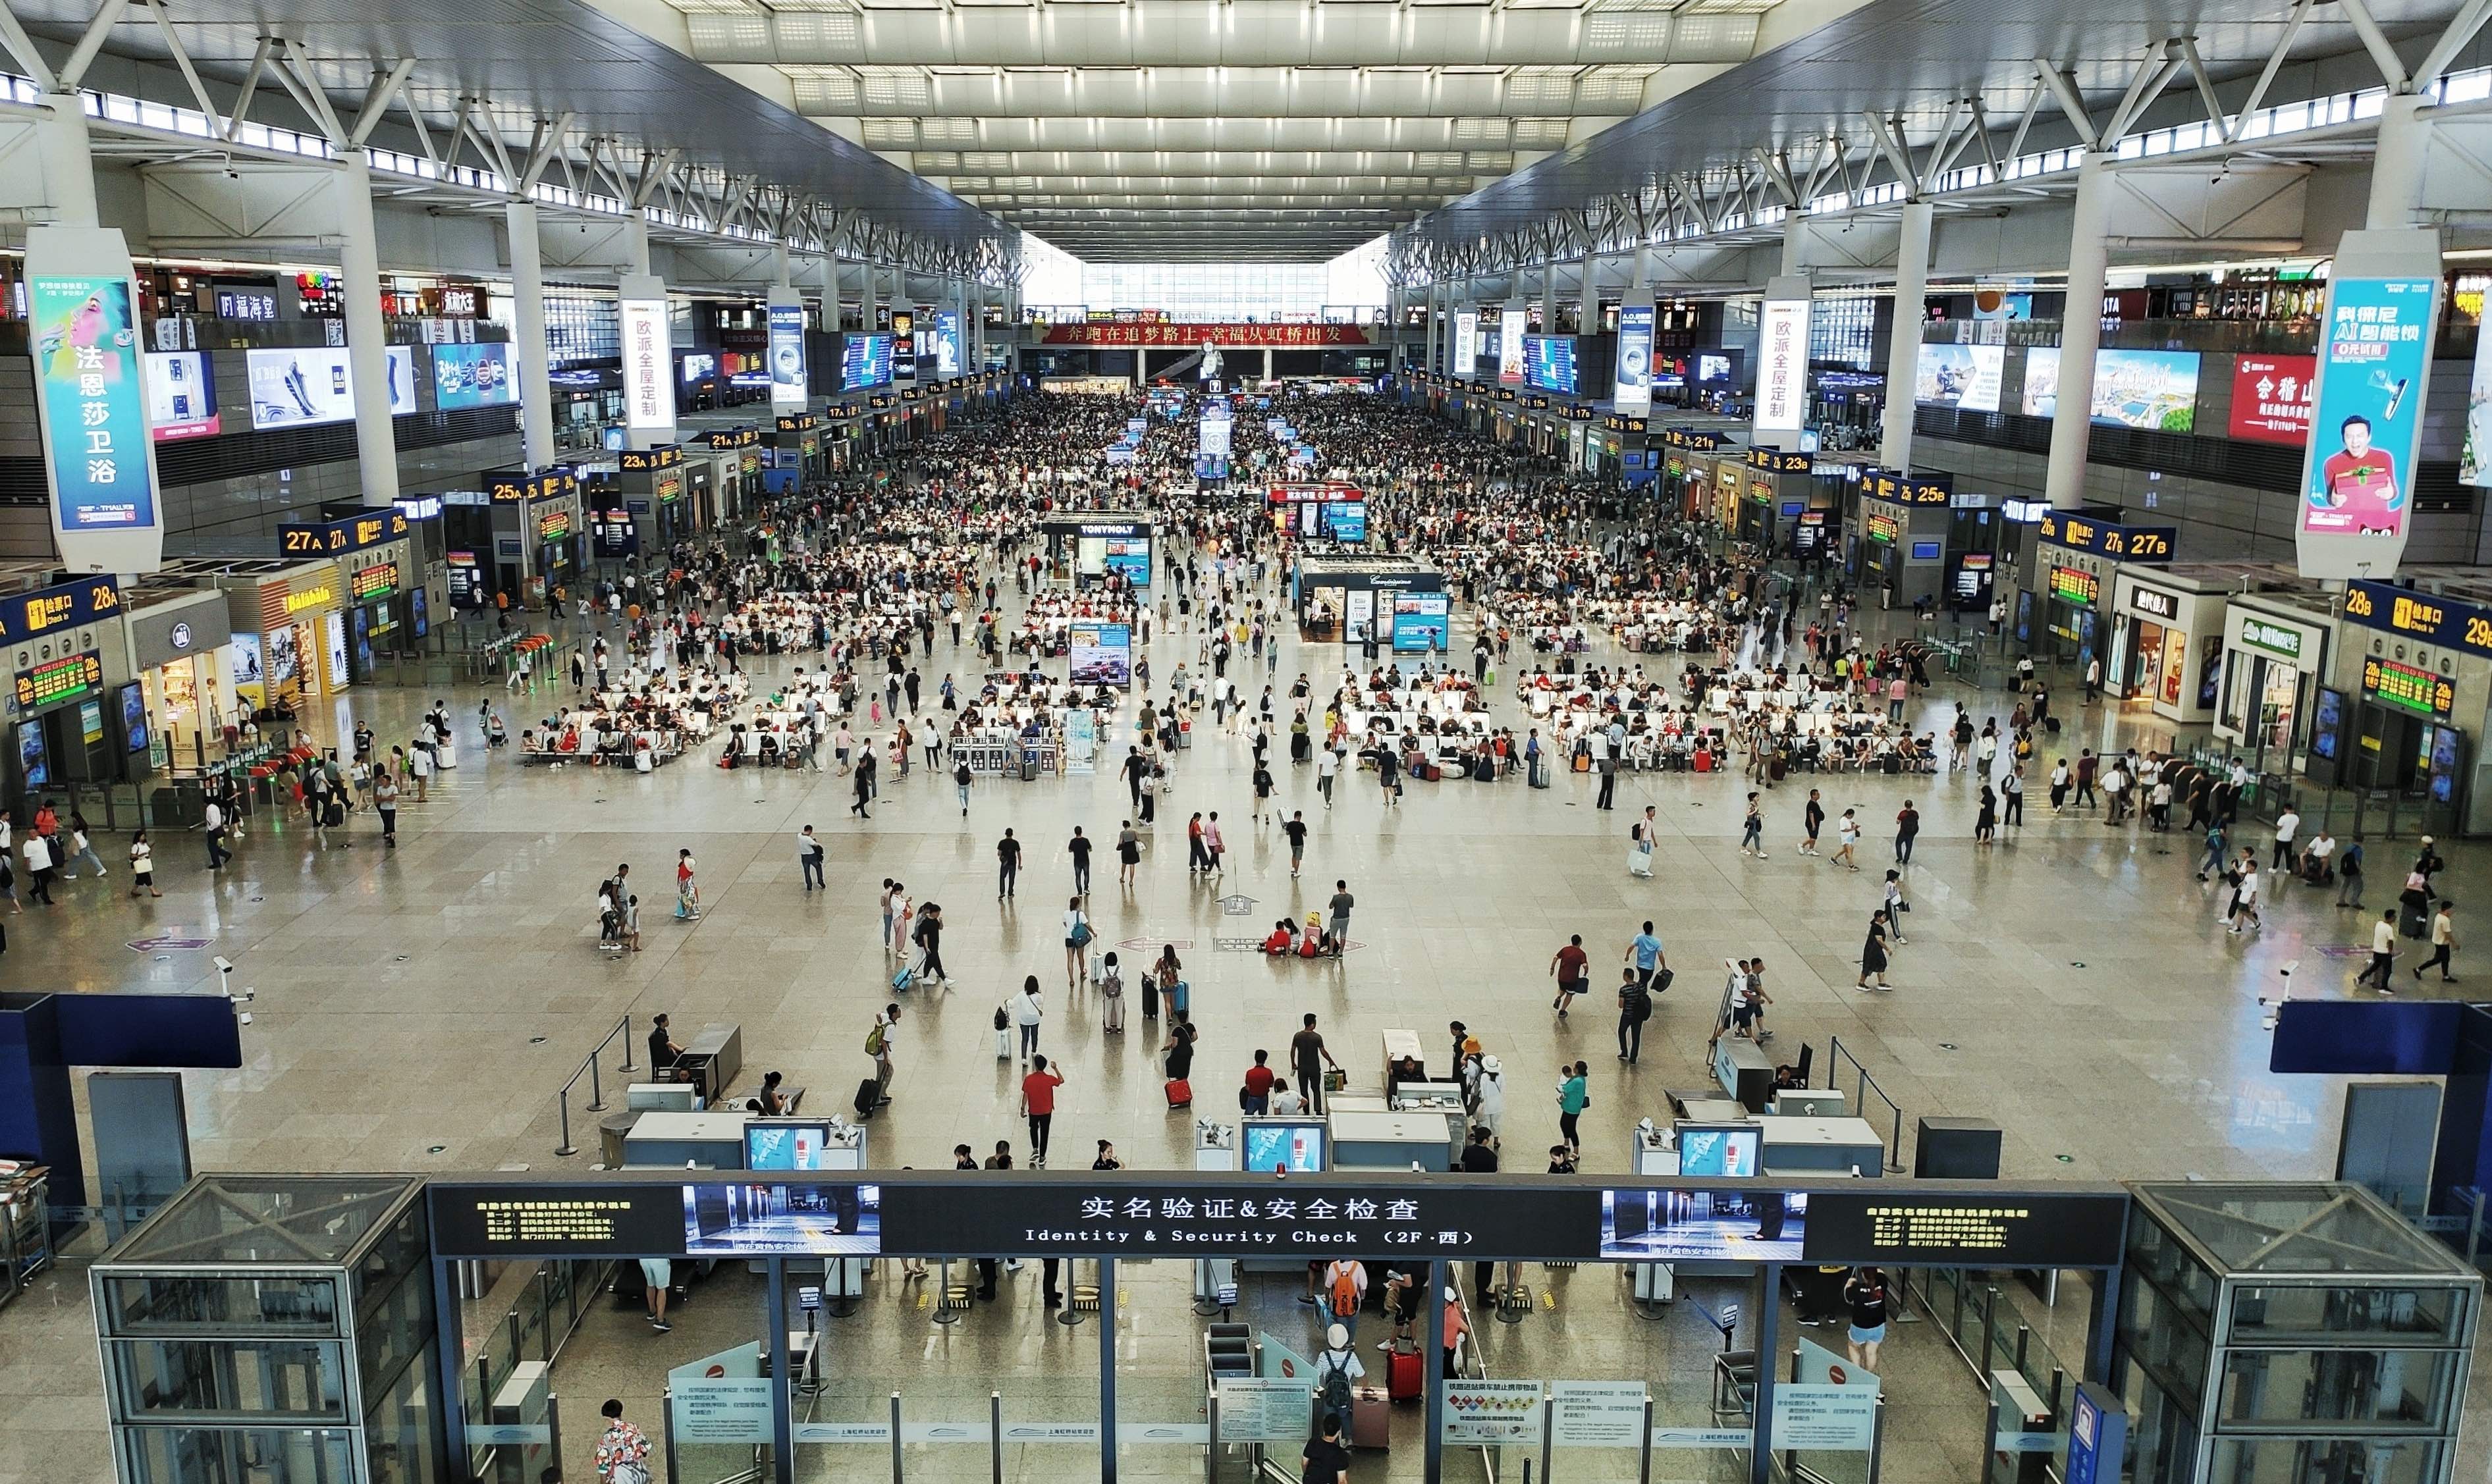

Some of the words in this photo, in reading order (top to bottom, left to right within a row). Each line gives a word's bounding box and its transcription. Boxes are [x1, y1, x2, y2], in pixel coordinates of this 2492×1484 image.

[236, 294, 275, 321] 福海堂
[445, 290, 475, 311] 永和大王
[2103, 297, 2119, 315] STA
[2173, 302, 2191, 311] LVERS
[1067, 326, 1198, 342] 奔跑在追梦路上
[1210, 326, 1341, 342] 幸福从虹桥出发
[2334, 322, 2420, 341] AI智能锁
[2339, 344, 2382, 356] 0元试用
[637, 320, 657, 417] 欧派全屋定制
[1770, 321, 1791, 417] 欧派全屋定制
[2256, 375, 2314, 402] 会稽山
[74, 344, 117, 485] 法恩莎卫浴
[829, 408, 844, 417] 17A
[1577, 410, 1590, 418] 17B
[779, 420, 796, 429] 19A
[1628, 421, 1643, 430] 19B
[713, 435, 732, 446] 21A
[1694, 437, 1714, 448] 21B
[624, 456, 646, 467] 23A
[1785, 457, 1808, 469] 23B
[495, 484, 522, 499] 25A
[1917, 487, 1945, 502] 25B
[393, 516, 407, 533] 26A
[1081, 525, 1133, 534] TONYMOLY
[2041, 517, 2055, 536] 26B
[286, 531, 323, 550] 27A
[330, 529, 347, 549] 27A
[2105, 531, 2123, 553] 27B
[2131, 534, 2167, 554] 27B
[45, 595, 72, 614] 检票口
[92, 585, 119, 611] 28A
[2137, 590, 2167, 616] 绝代佳人
[2346, 589, 2372, 616] 28B
[47, 614, 62, 624] Check
[2412, 602, 2443, 625] 检票口
[2411, 620, 2427, 633] Check
[2429, 625, 2435, 634] in
[85, 657, 99, 672] 28A
[2366, 661, 2380, 677] 28B
[18, 677, 33, 693] 29A
[2436, 682, 2452, 699] 29B
[1081, 1196, 1419, 1221] 实名验证&安全检查
[1025, 1229, 1130, 1244] Identity
[1145, 1231, 1156, 1241] &
[1172, 1229, 1278, 1244] Security
[1292, 1229, 1358, 1243] Check
